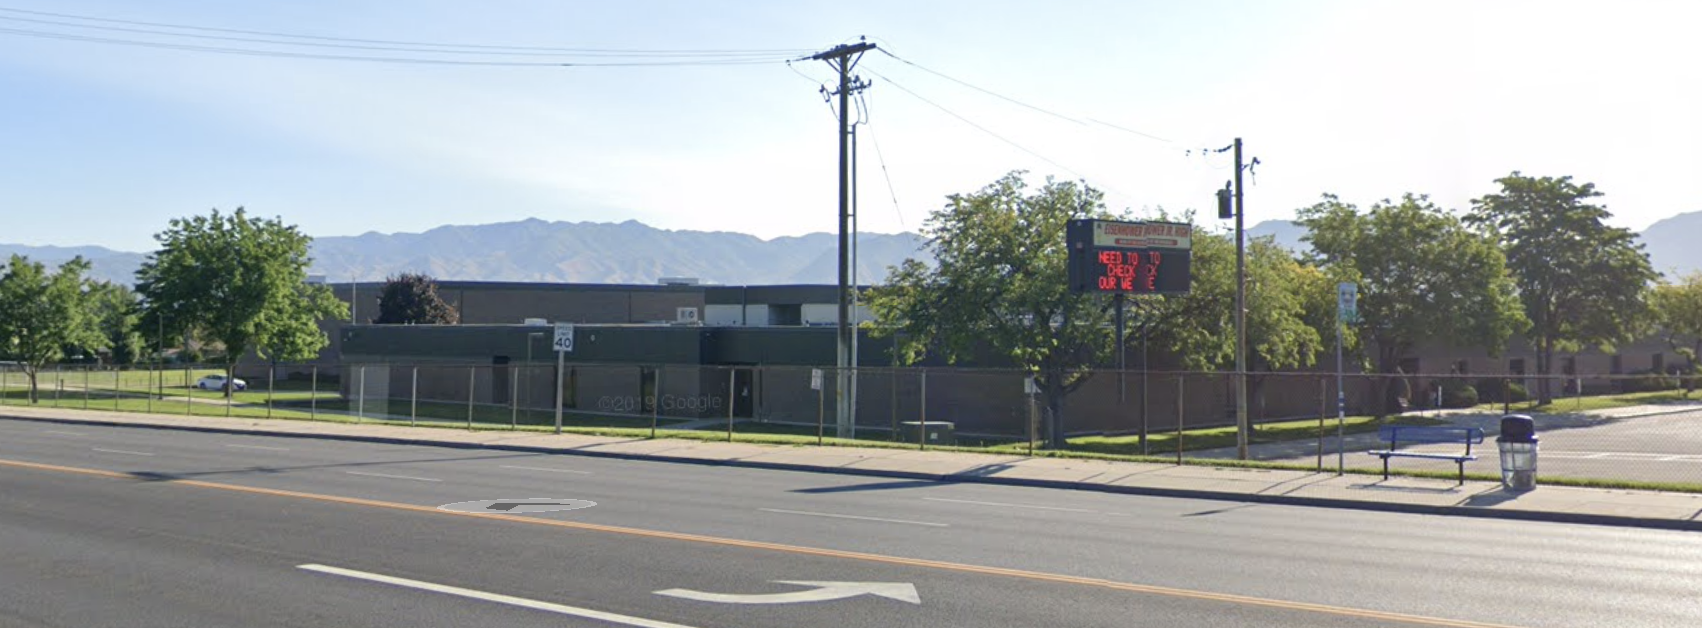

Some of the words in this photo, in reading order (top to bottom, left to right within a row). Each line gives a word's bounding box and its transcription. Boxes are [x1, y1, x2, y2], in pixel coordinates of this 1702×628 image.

[1098, 251, 1122, 263] NEED
[1127, 252, 1138, 265] TO
[1107, 264, 1136, 277] CHECK
[1098, 277, 1116, 289] OUR
[1120, 278, 1133, 290] WE
[555, 337, 572, 348] 40
